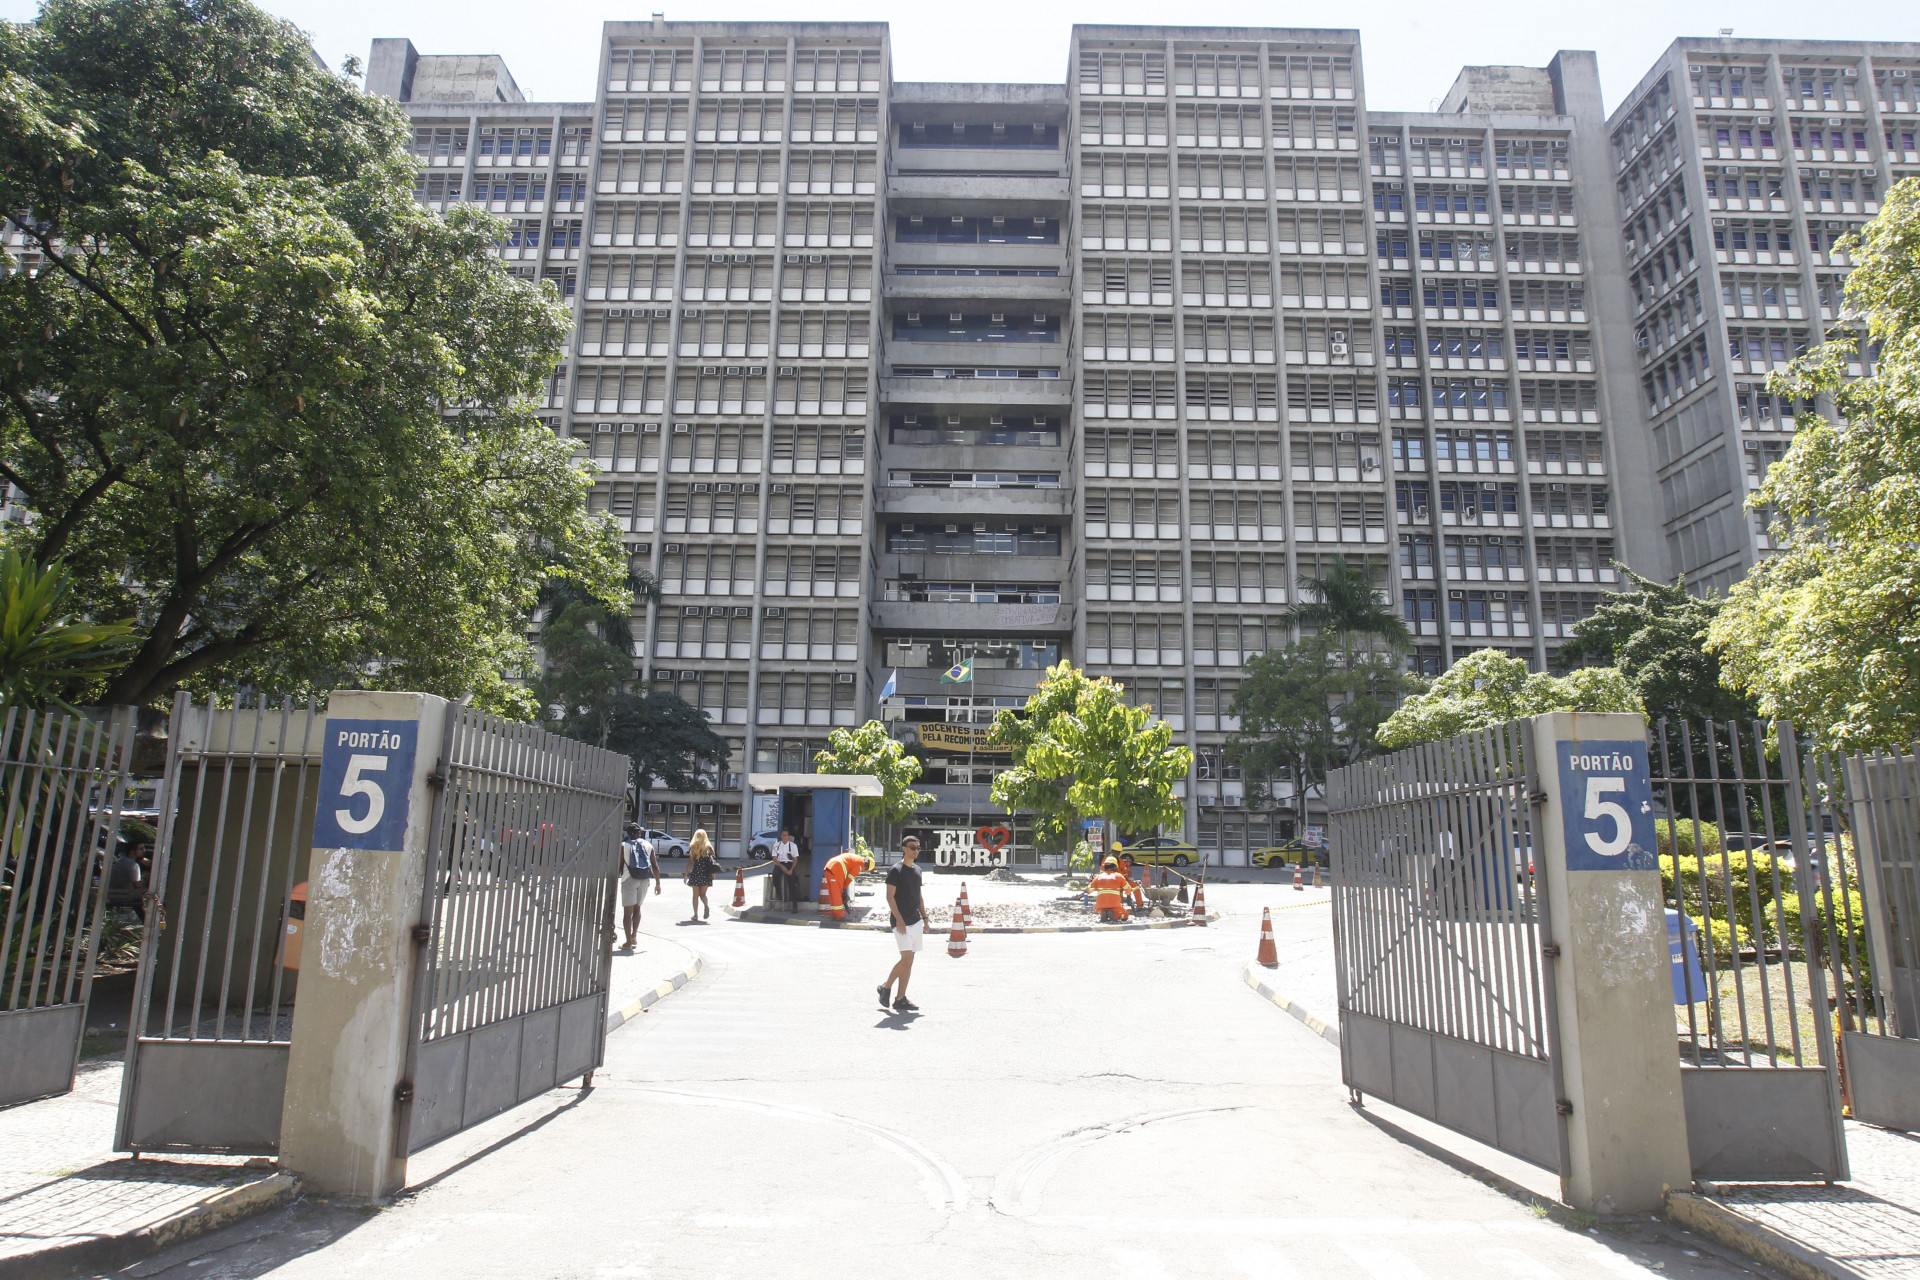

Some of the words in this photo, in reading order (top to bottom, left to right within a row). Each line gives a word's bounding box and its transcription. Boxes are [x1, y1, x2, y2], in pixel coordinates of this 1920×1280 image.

[922, 724, 970, 735] DOCENTES
[922, 733, 942, 742] PELA
[338, 730, 401, 750] PORTÃO
[1569, 751, 1633, 771] PORTÃO
[335, 753, 389, 834] 5
[1583, 776, 1633, 857] 5
[933, 830, 976, 849] EU
[933, 848, 1010, 867] UERJ
